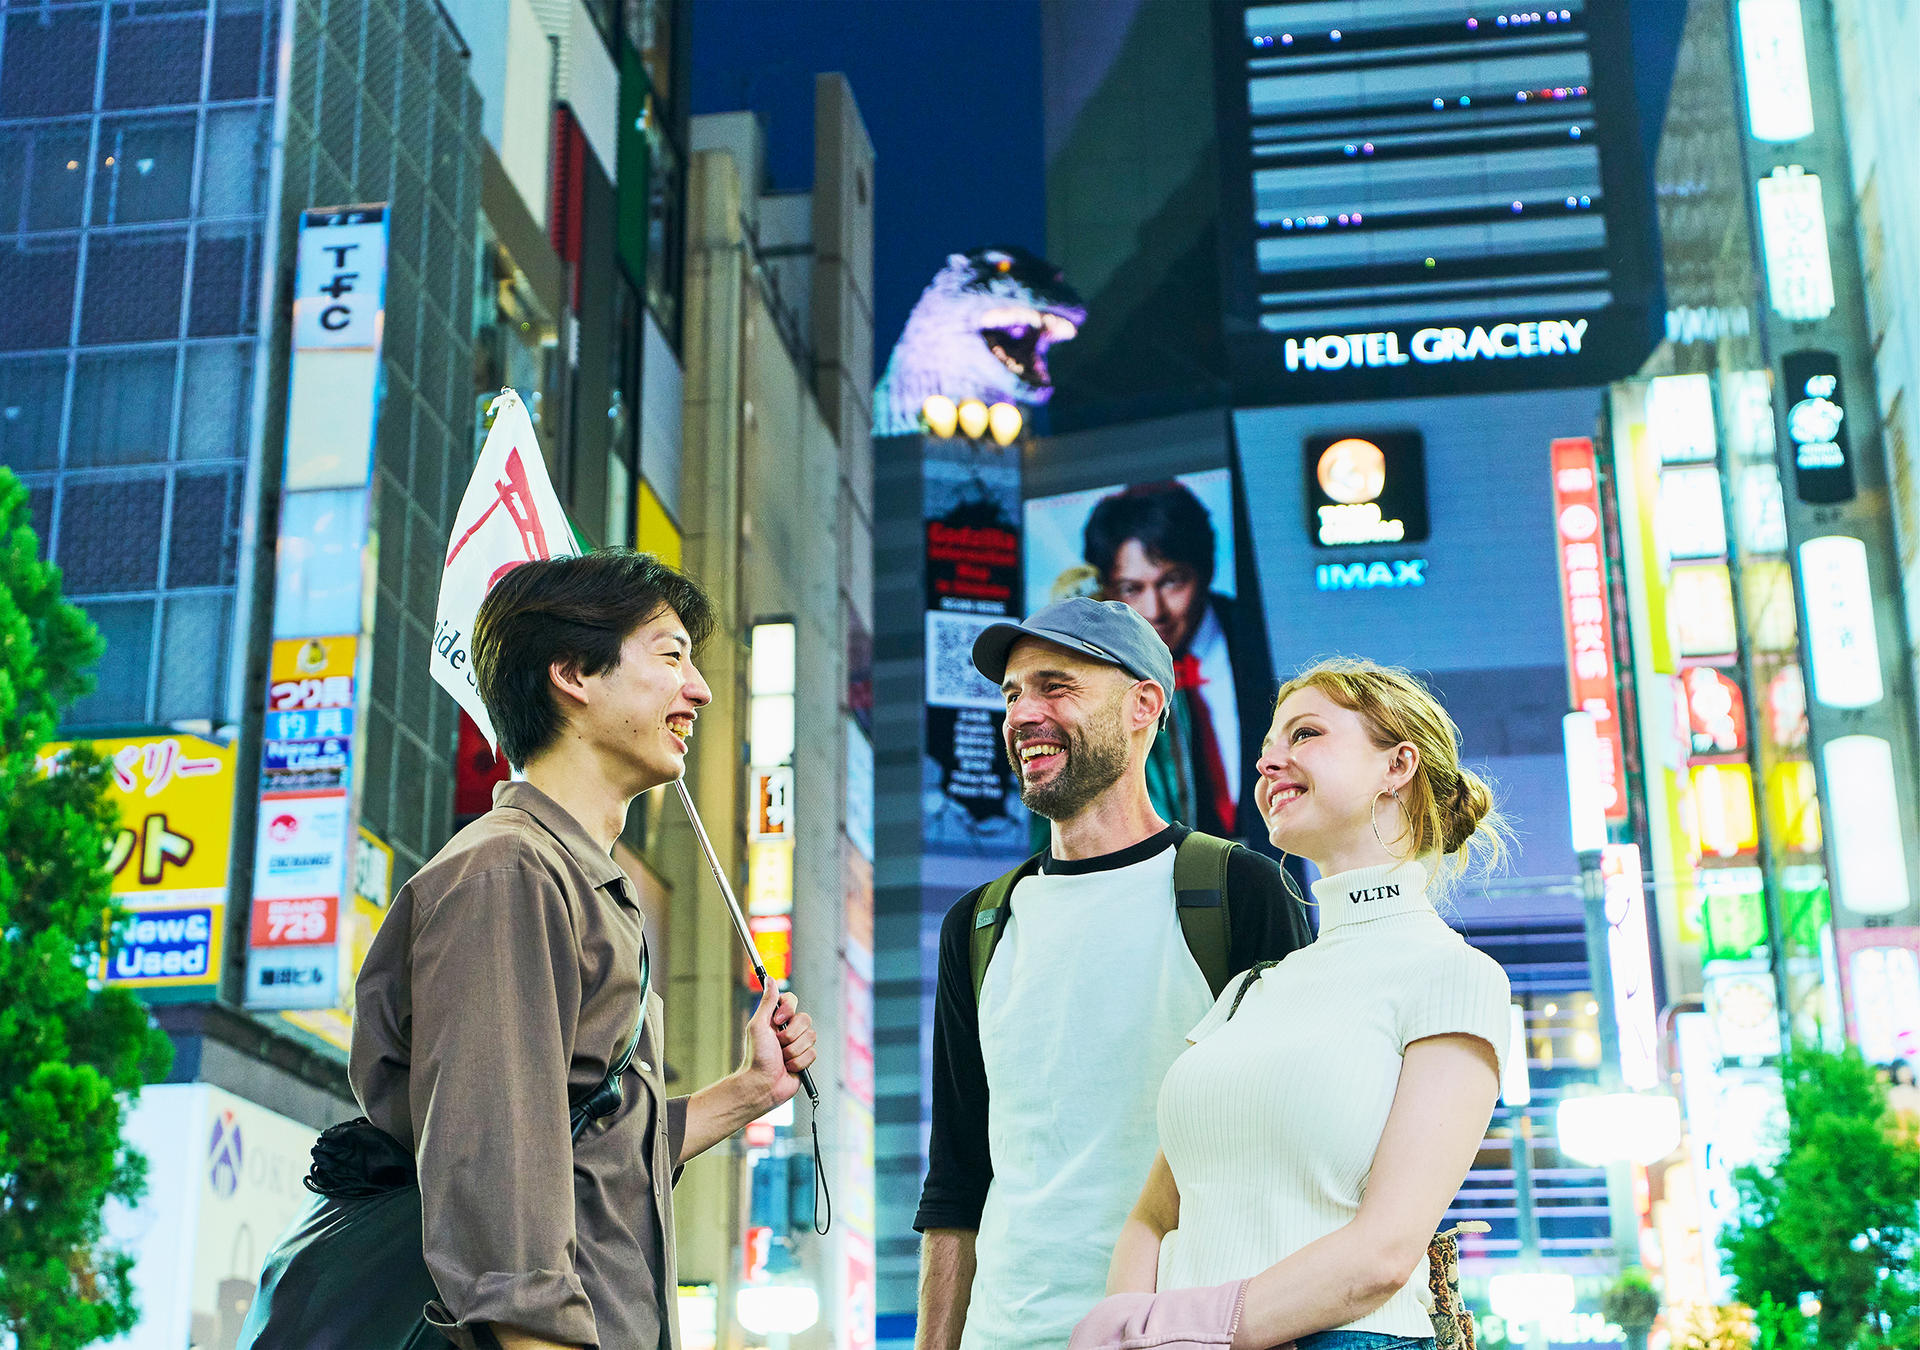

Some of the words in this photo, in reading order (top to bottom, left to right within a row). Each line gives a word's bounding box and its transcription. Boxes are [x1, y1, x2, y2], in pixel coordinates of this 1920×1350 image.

[1284, 331, 1409, 372] HOTEL
[1410, 318, 1588, 364] GRACERY
[1315, 559, 1426, 591] IMAX
[270, 675, 350, 710] つり具
[1349, 884, 1401, 904] VLTN
[266, 912, 328, 942] 729
[116, 943, 207, 977] Used
